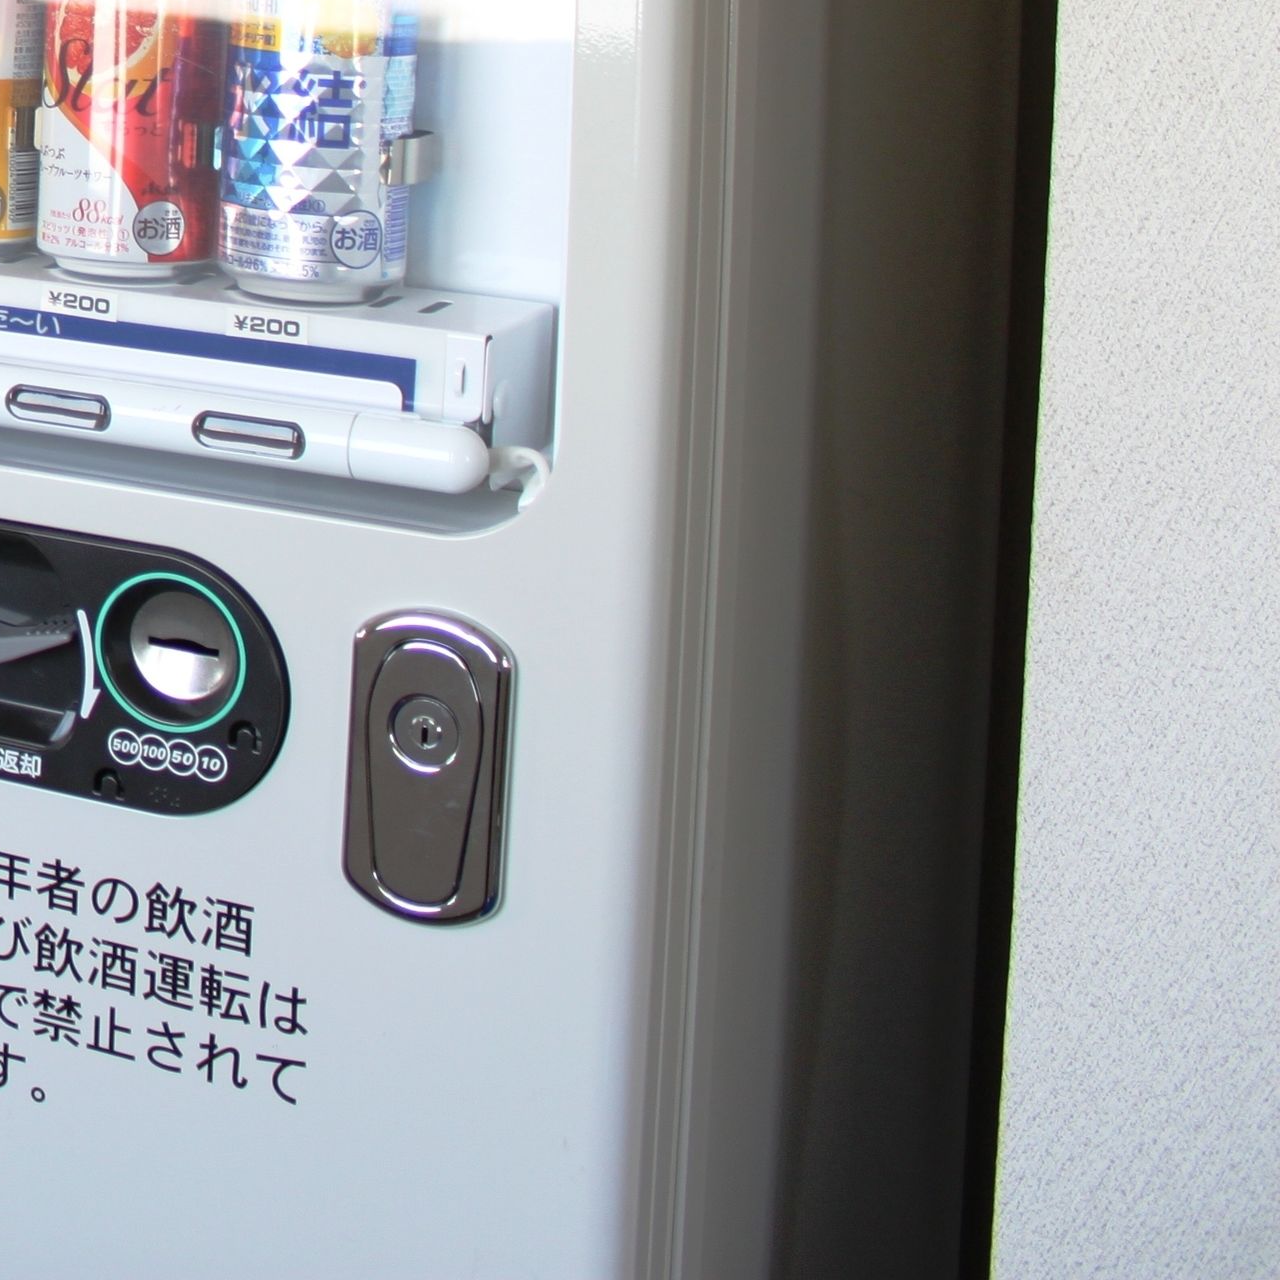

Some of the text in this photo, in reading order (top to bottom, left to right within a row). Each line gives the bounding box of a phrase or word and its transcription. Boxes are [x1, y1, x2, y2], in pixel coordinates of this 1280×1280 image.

[136, 217, 182, 241] お酒
[334, 228, 379, 252] お酒
[48, 290, 110, 314] ¥200
[234, 313, 301, 338] ¥200
[111, 737, 222, 775] 500 100 50 10
